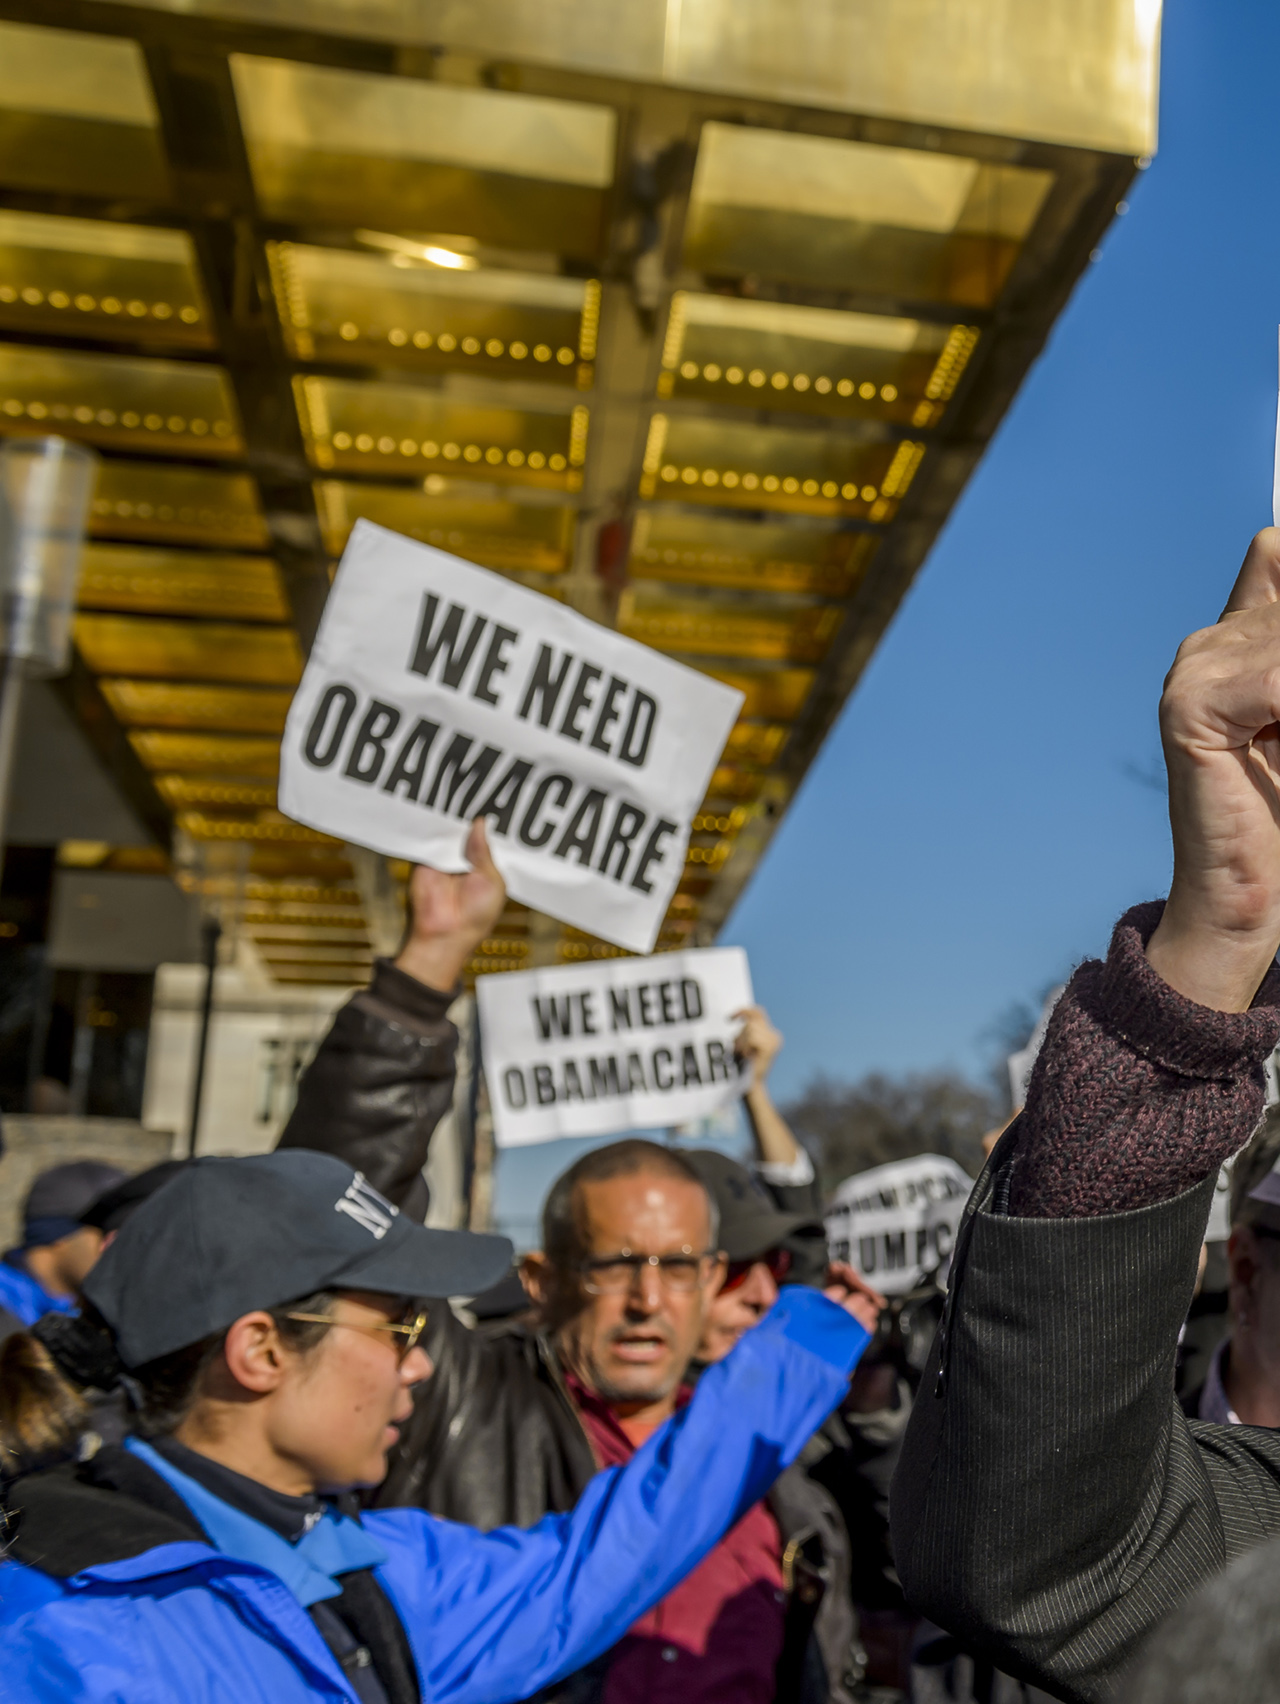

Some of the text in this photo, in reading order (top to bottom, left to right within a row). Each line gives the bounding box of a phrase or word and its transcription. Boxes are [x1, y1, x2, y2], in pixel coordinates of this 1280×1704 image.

[407, 590, 660, 769] WE NEED
[304, 684, 679, 896] OBAMACARE
[532, 978, 704, 1040] WE NEED
[503, 1039, 742, 1110] OBAMACAR
